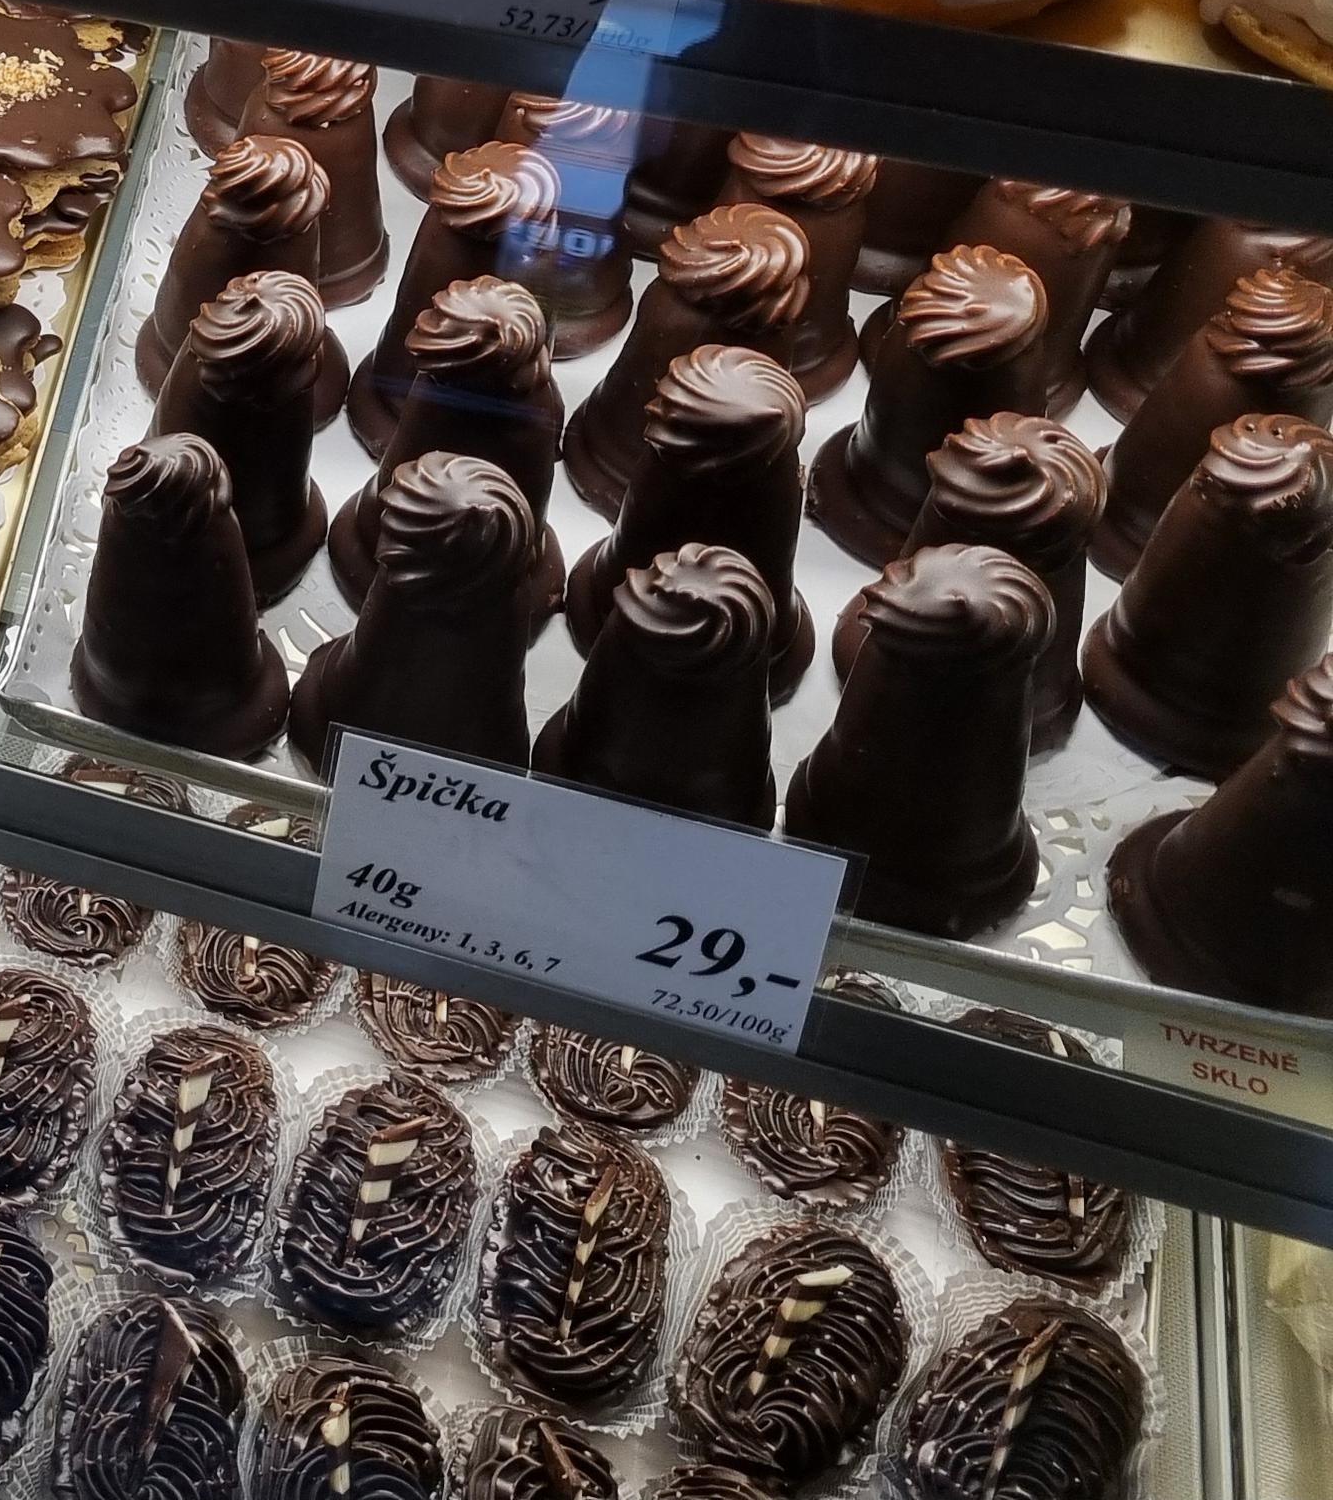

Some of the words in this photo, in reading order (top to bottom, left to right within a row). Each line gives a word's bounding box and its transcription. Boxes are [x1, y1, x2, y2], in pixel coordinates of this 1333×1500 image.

[358, 749, 510, 823] Špička
[345, 862, 422, 910] 40g
[336, 900, 452, 945] Alergeny:
[456, 931, 477, 957] 1,
[484, 939, 506, 963] 3,
[514, 946, 536, 972] 6,
[547, 956, 563, 975] 7
[636, 914, 801, 999] 29,-
[650, 988, 789, 1044] 72,50/100g
[1159, 1022, 1301, 1076] TVRZENÉ
[1192, 1061, 1269, 1095] SKLO
